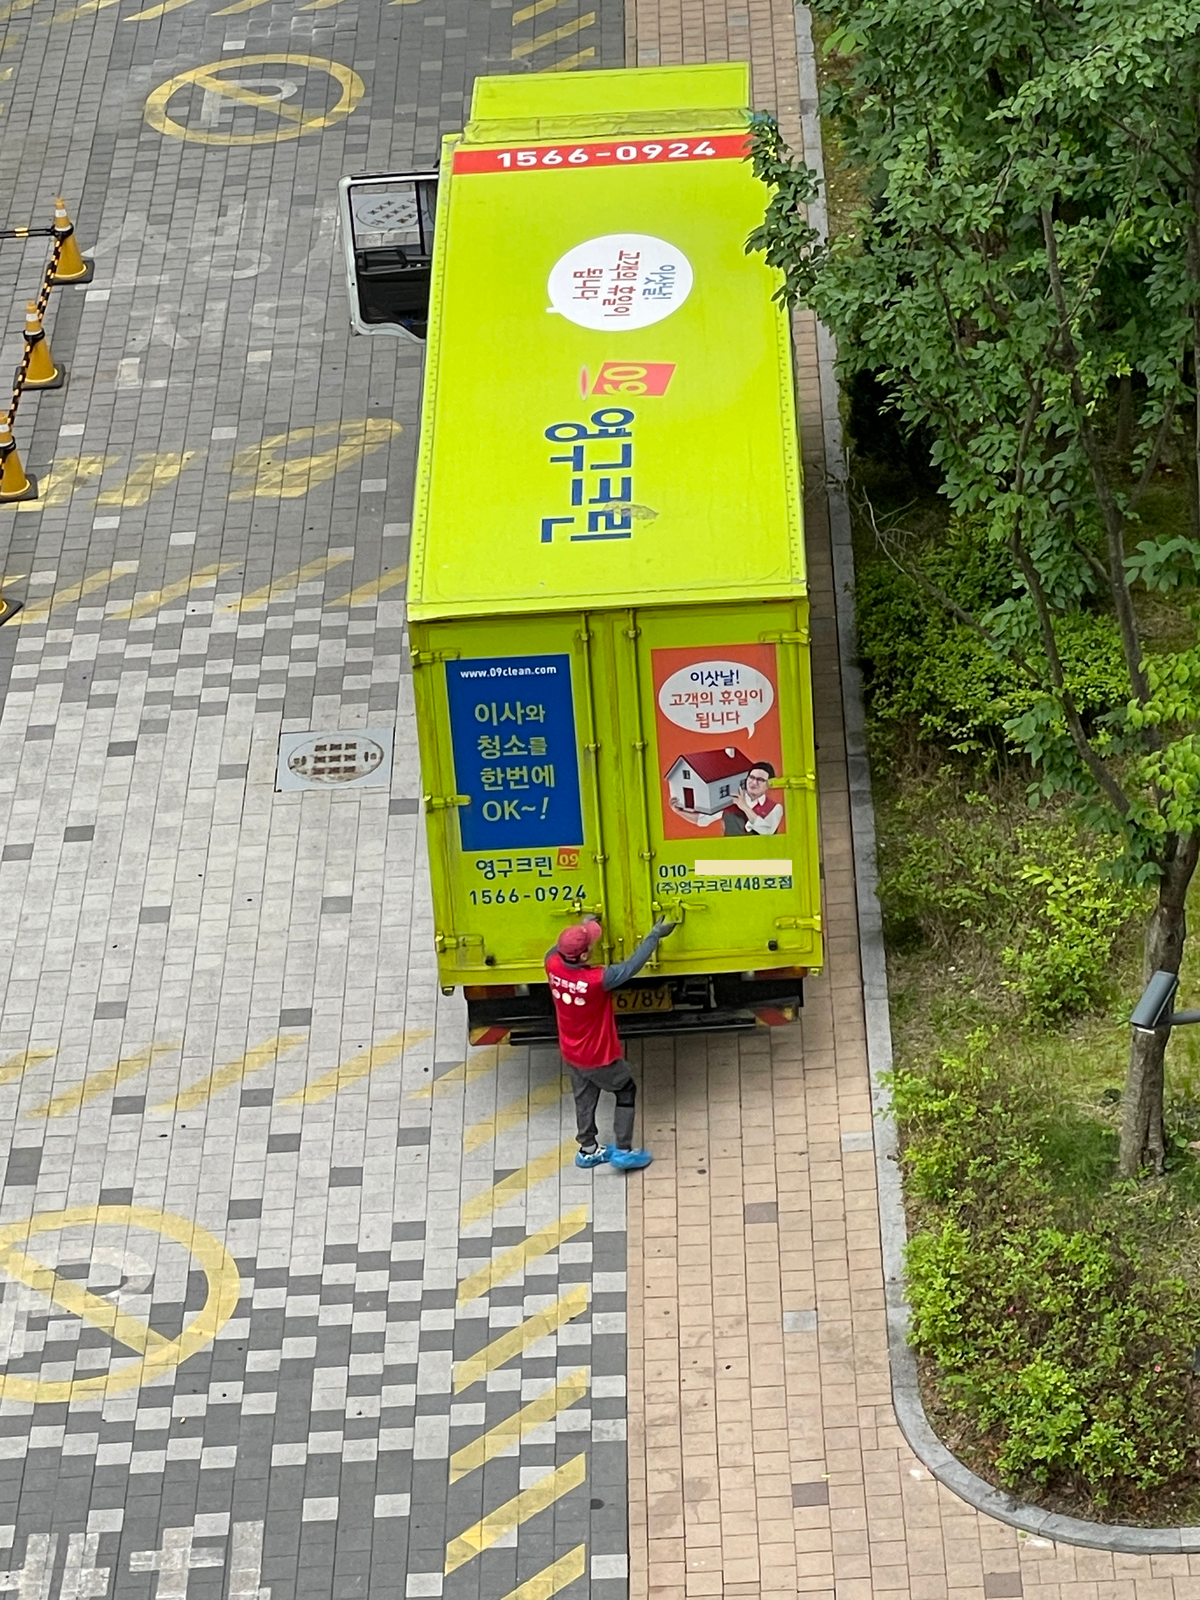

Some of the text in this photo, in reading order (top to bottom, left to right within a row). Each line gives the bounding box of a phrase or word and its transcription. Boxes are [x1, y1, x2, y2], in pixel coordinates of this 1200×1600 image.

[496, 140, 717, 168] 1566-0924
[572, 266, 604, 301] 됩니다
[601, 249, 641, 317] 고객의 휴일이
[641, 263, 676, 301] 이삿날!
[540, 407, 635, 544] 영구크린
[459, 665, 557, 679] www.09clean.com
[690, 669, 741, 688] 이삿날!
[669, 688, 764, 709] 고객의 휴일이
[474, 701, 546, 727] 이사와
[695, 710, 741, 729] 됩니다
[477, 734, 548, 760] 청소를
[479, 763, 556, 792] 한번에
[475, 852, 580, 881] 영구크린 09
[469, 884, 588, 906] 1566-0924
